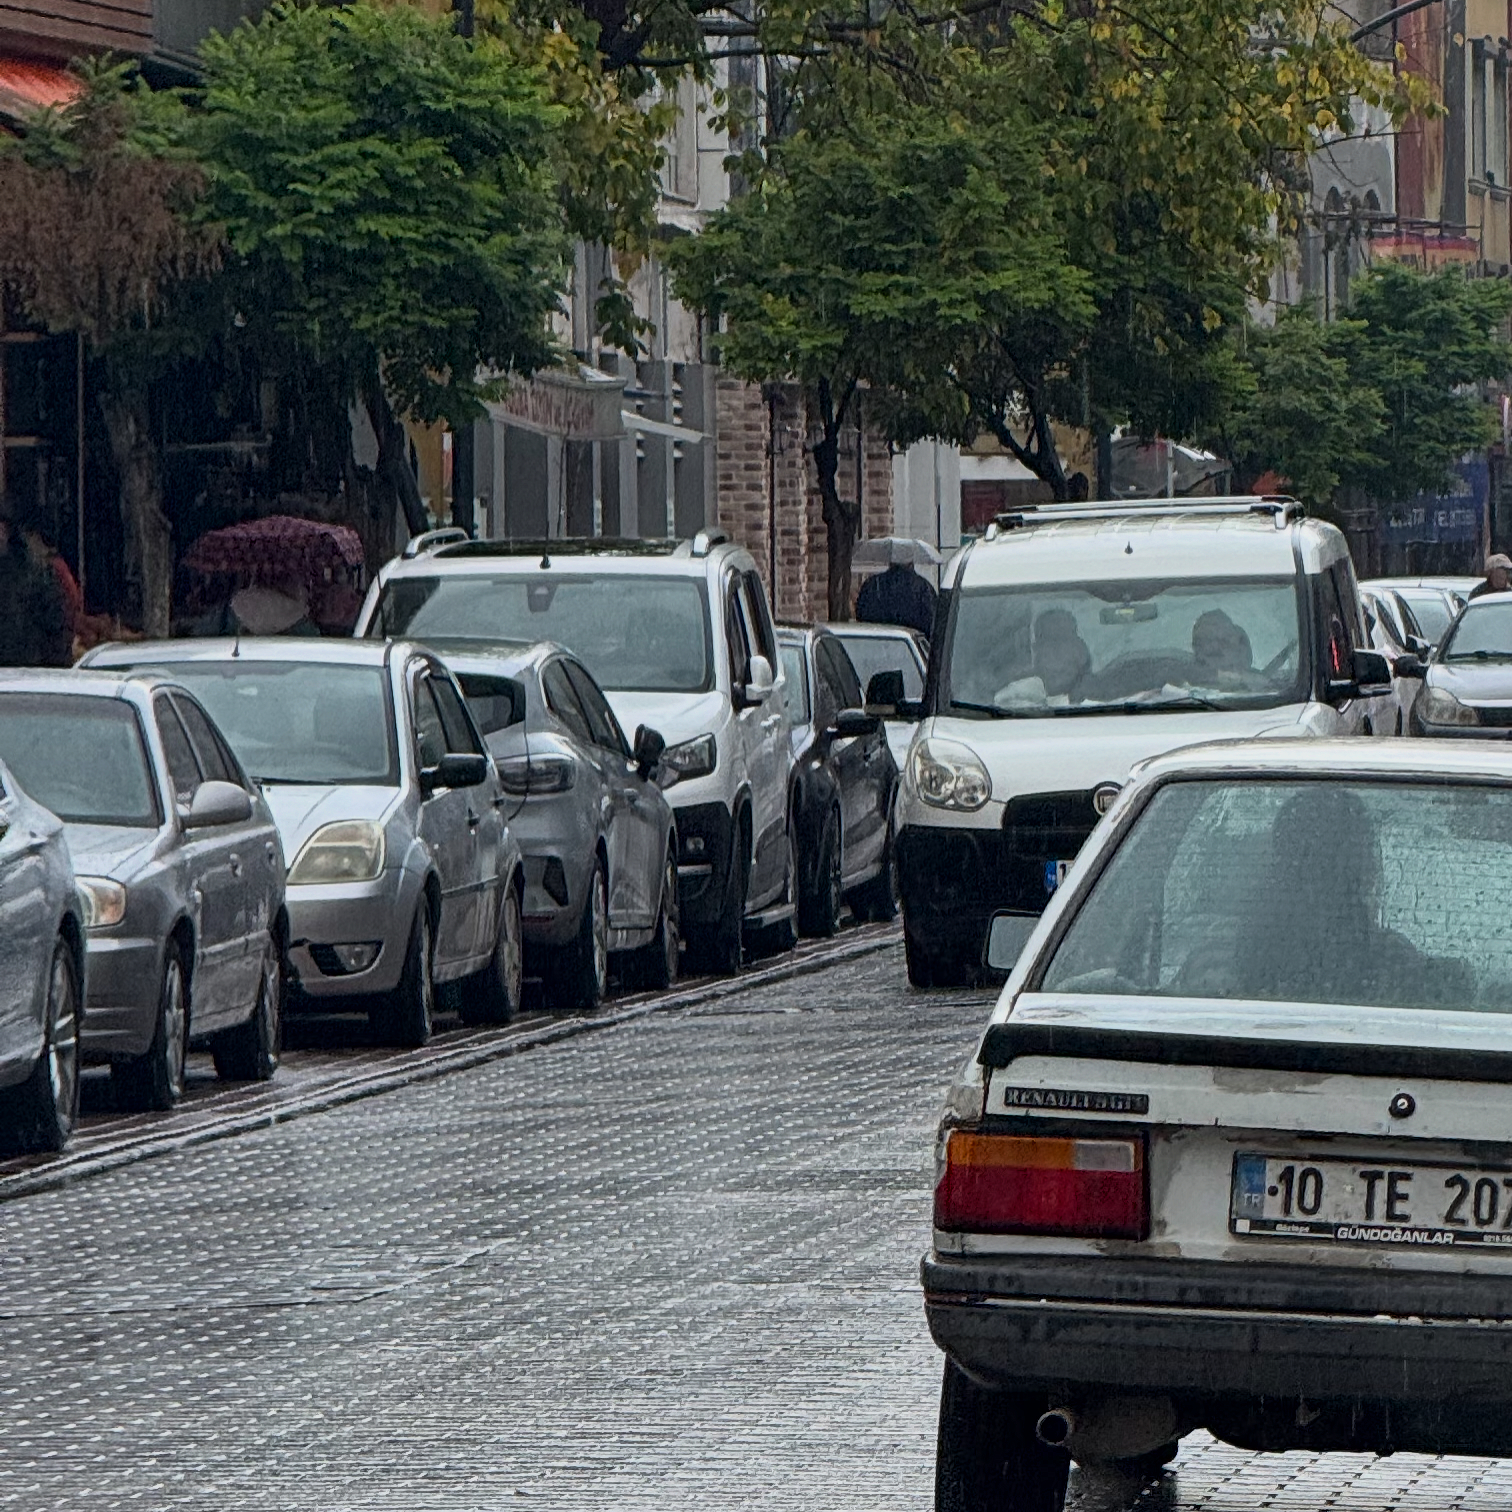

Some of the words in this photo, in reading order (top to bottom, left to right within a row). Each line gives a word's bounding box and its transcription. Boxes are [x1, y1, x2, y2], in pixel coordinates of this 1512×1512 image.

[1278, 1164, 1324, 1216] 10
[1359, 1170, 1414, 1223] TE
[1336, 1225, 1455, 1245] GÜNDOĞANLAR
